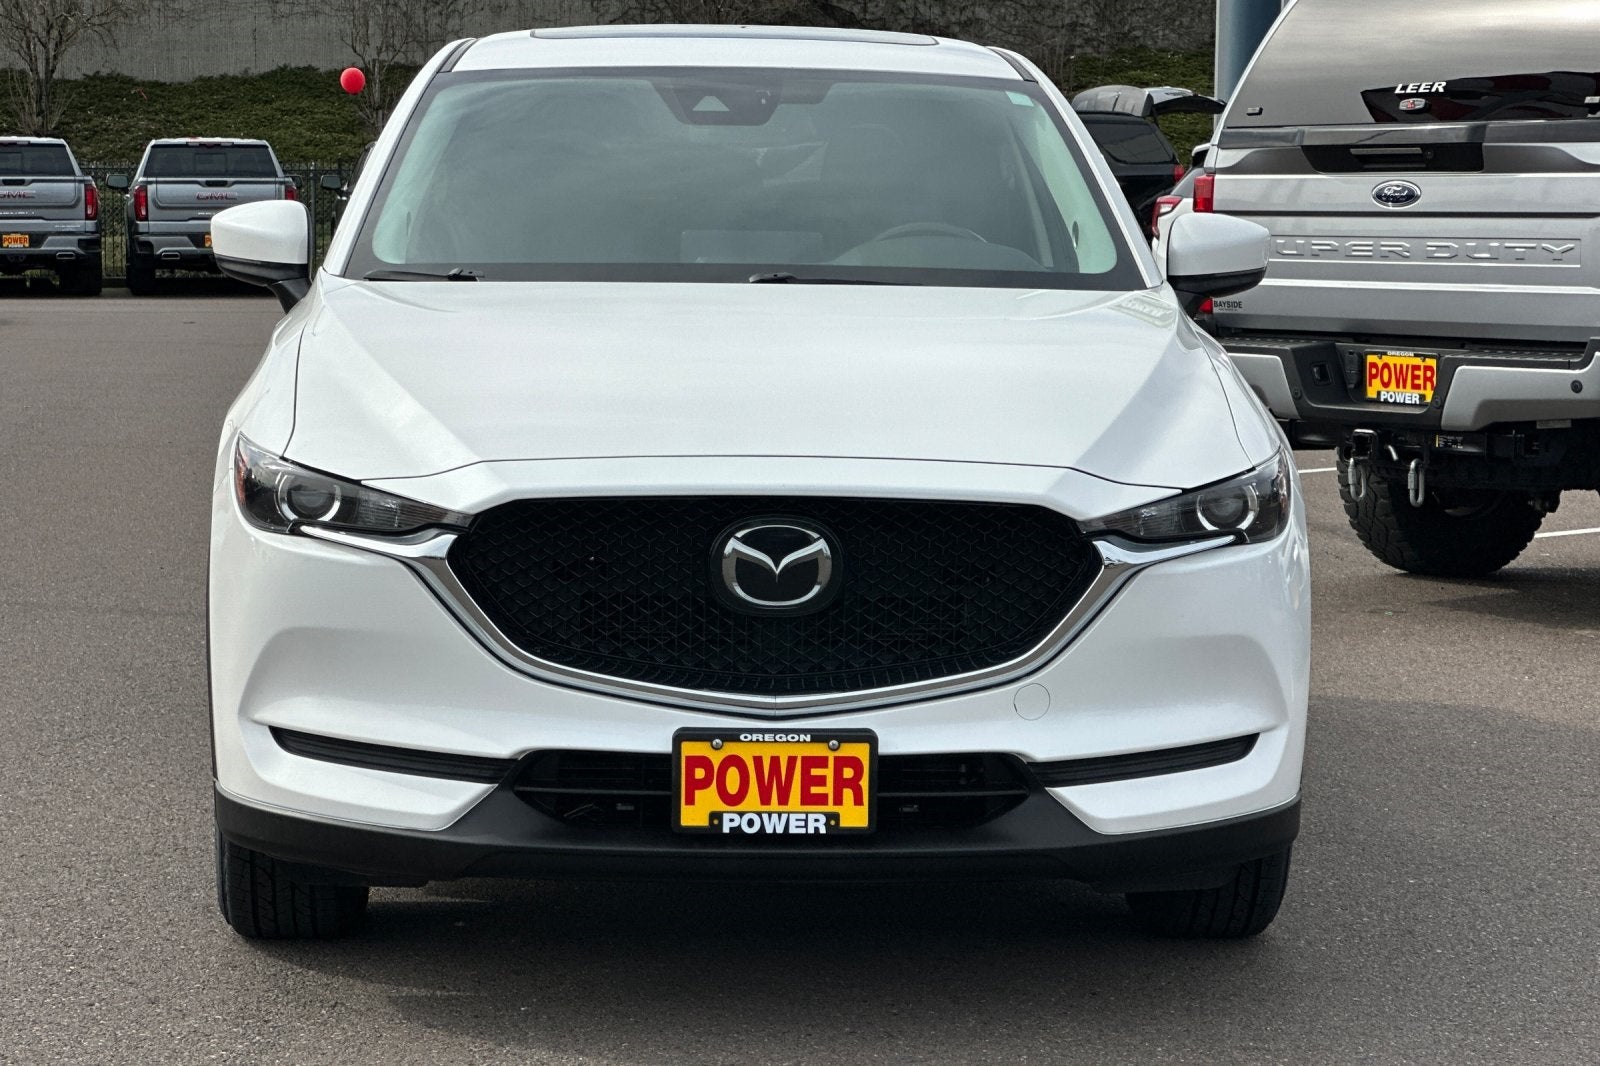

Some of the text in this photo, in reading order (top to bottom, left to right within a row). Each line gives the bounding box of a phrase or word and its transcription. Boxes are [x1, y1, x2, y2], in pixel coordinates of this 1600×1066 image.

[1394, 81, 1447, 94] LEER
[195, 191, 238, 201] GMC
[1382, 186, 1409, 199] Ford
[3, 236, 28, 244] POWER
[1275, 239, 1576, 261] UPER DUTY
[1213, 300, 1243, 309] BAYSIDE
[1368, 361, 1436, 391] POWER
[1380, 391, 1420, 404] POWER
[739, 733, 811, 742] OREGON
[684, 754, 865, 807] POWER
[722, 812, 827, 834] POWER
